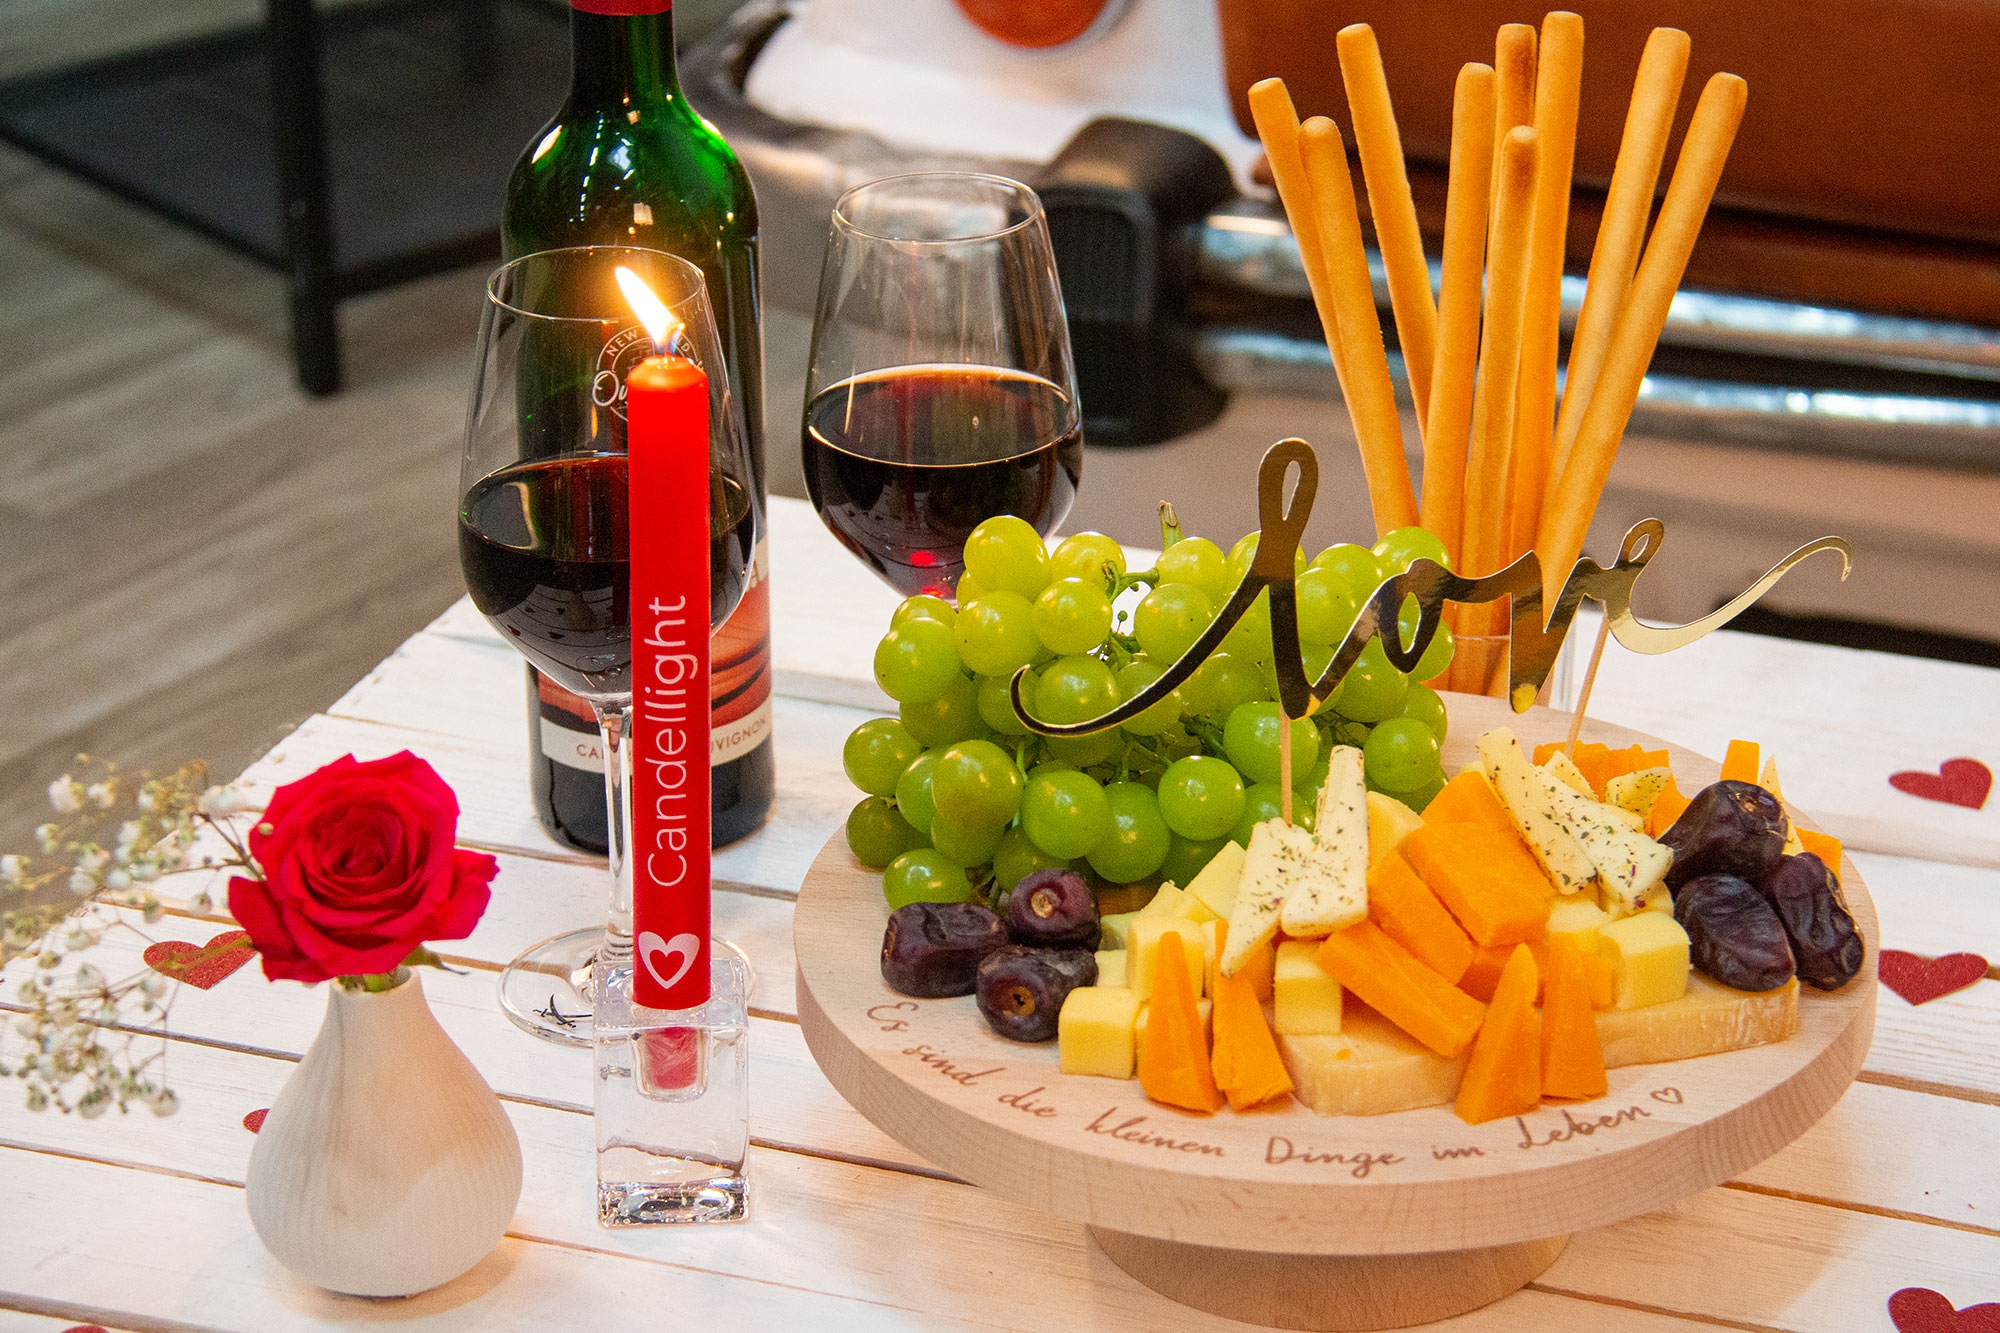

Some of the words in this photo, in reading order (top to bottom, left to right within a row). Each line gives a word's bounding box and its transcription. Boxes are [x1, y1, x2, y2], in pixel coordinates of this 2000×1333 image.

[606, 329, 639, 357] NEW
[644, 595, 698, 886] Candellight
[710, 718, 767, 753] VIGNON
[866, 1001, 919, 1032] Es
[902, 1043, 1006, 1087] sind
[998, 1086, 1058, 1119] die
[1083, 1106, 1227, 1158] kleinen
[1264, 1135, 1406, 1179] Dinge
[1431, 1143, 1486, 1162] im
[1516, 1099, 1653, 1150] Leben
